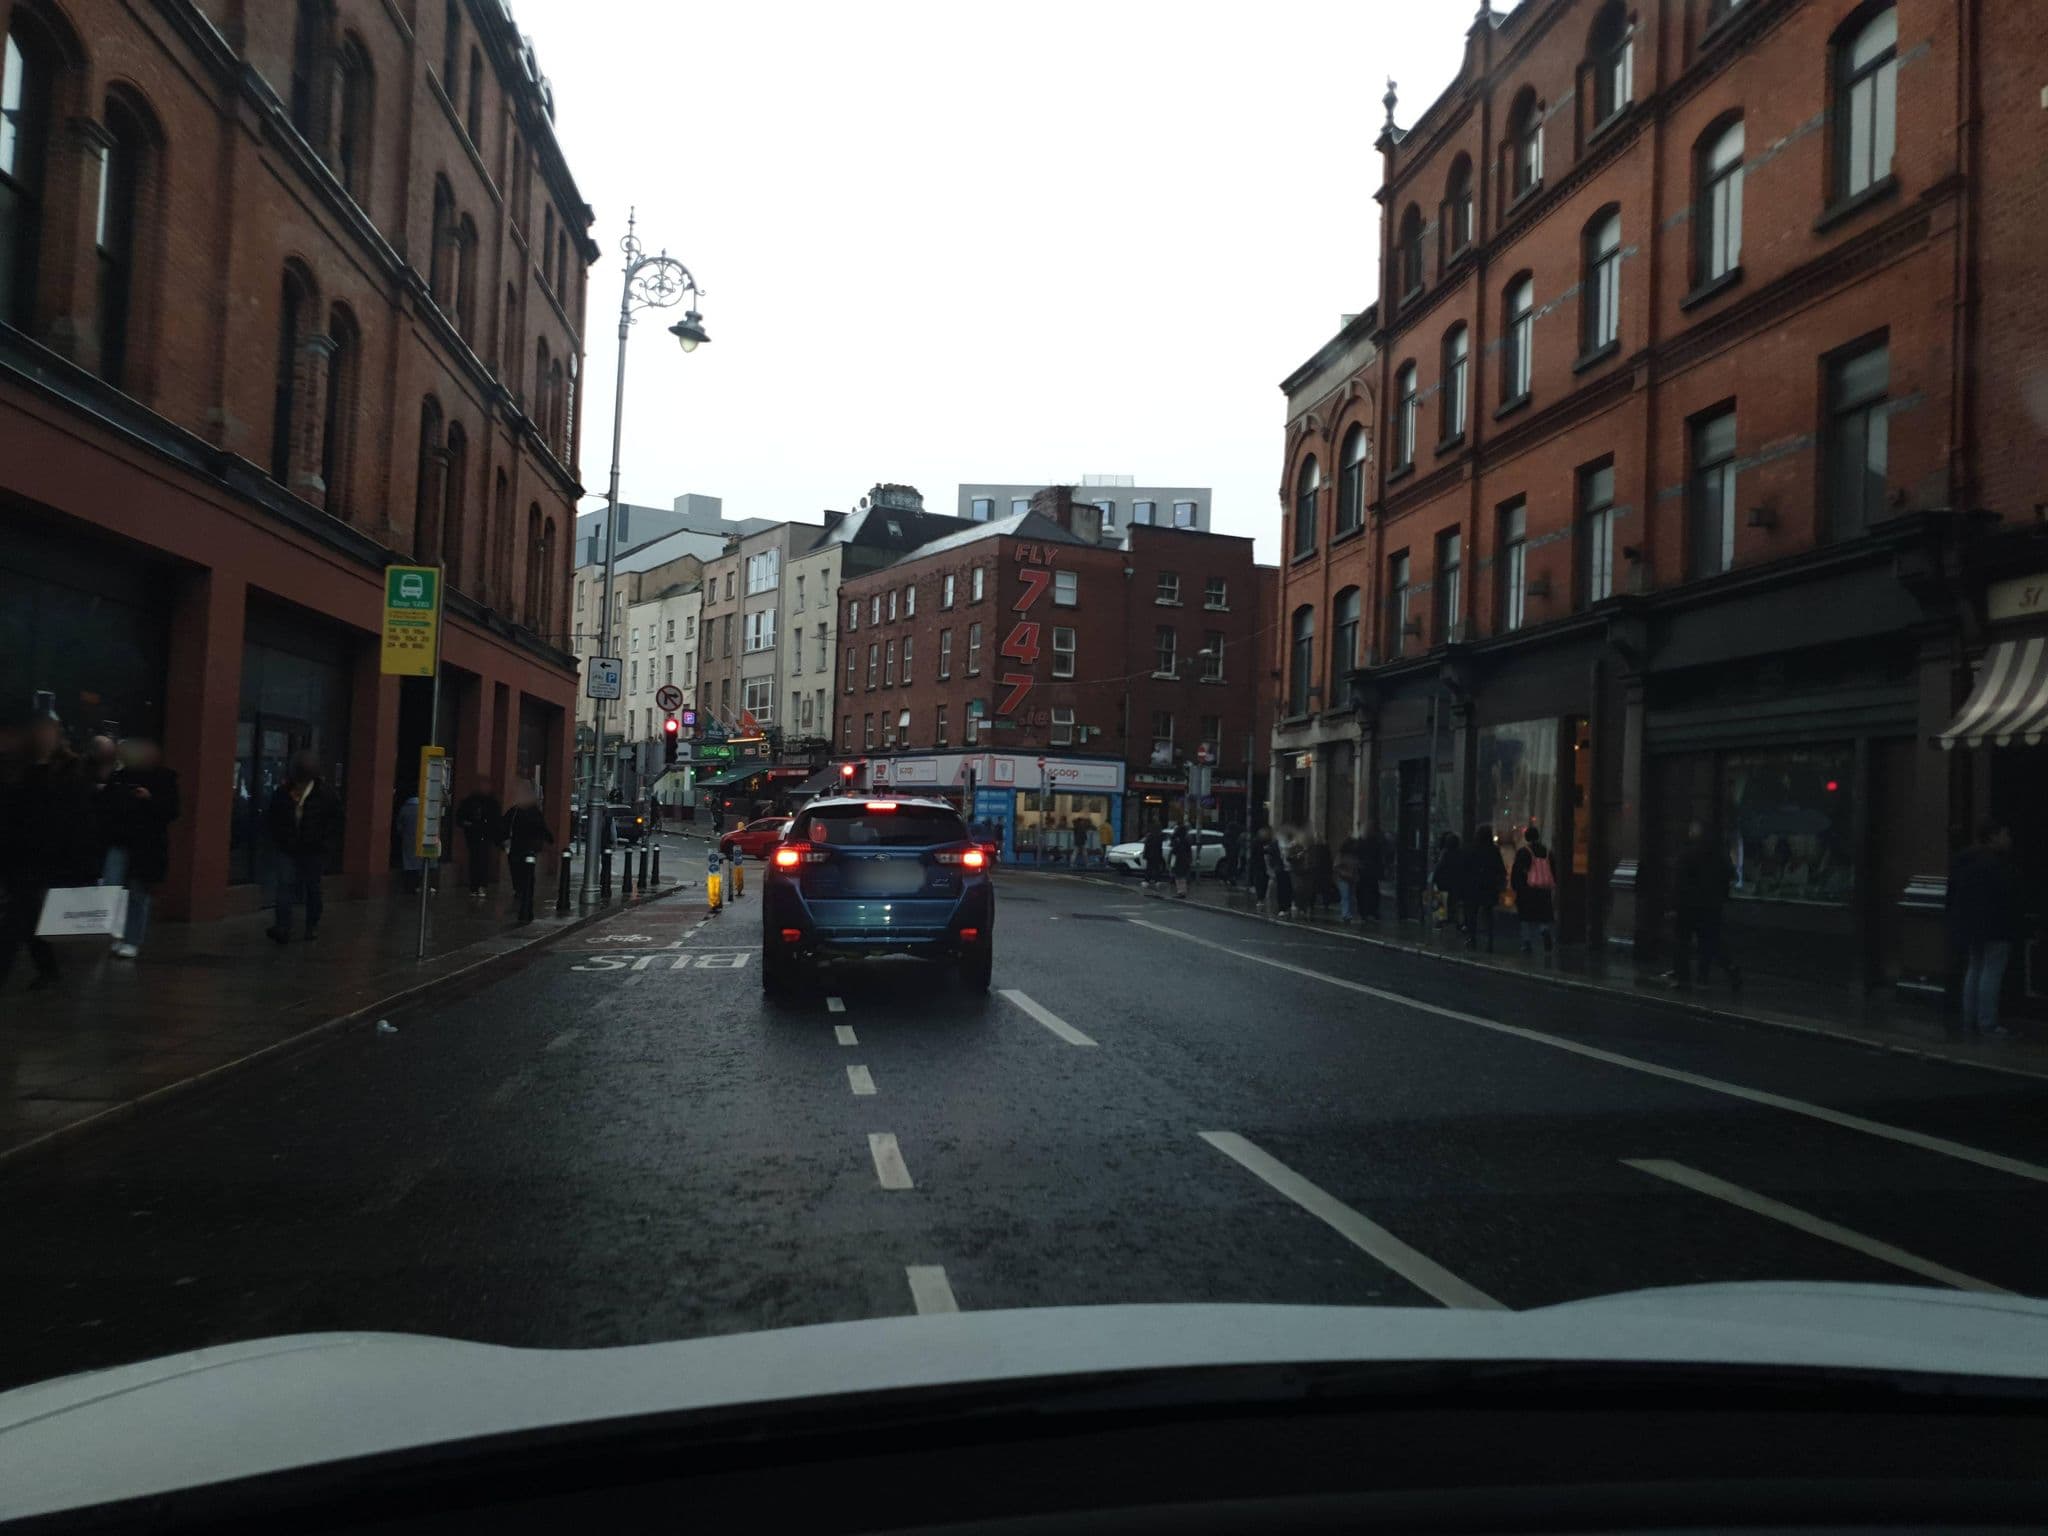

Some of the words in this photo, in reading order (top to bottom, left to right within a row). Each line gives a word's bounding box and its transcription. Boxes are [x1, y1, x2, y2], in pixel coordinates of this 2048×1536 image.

[1015, 543, 1058, 566] FLY
[1048, 768, 1079, 779] scoop
[570, 953, 750, 971] BUS
